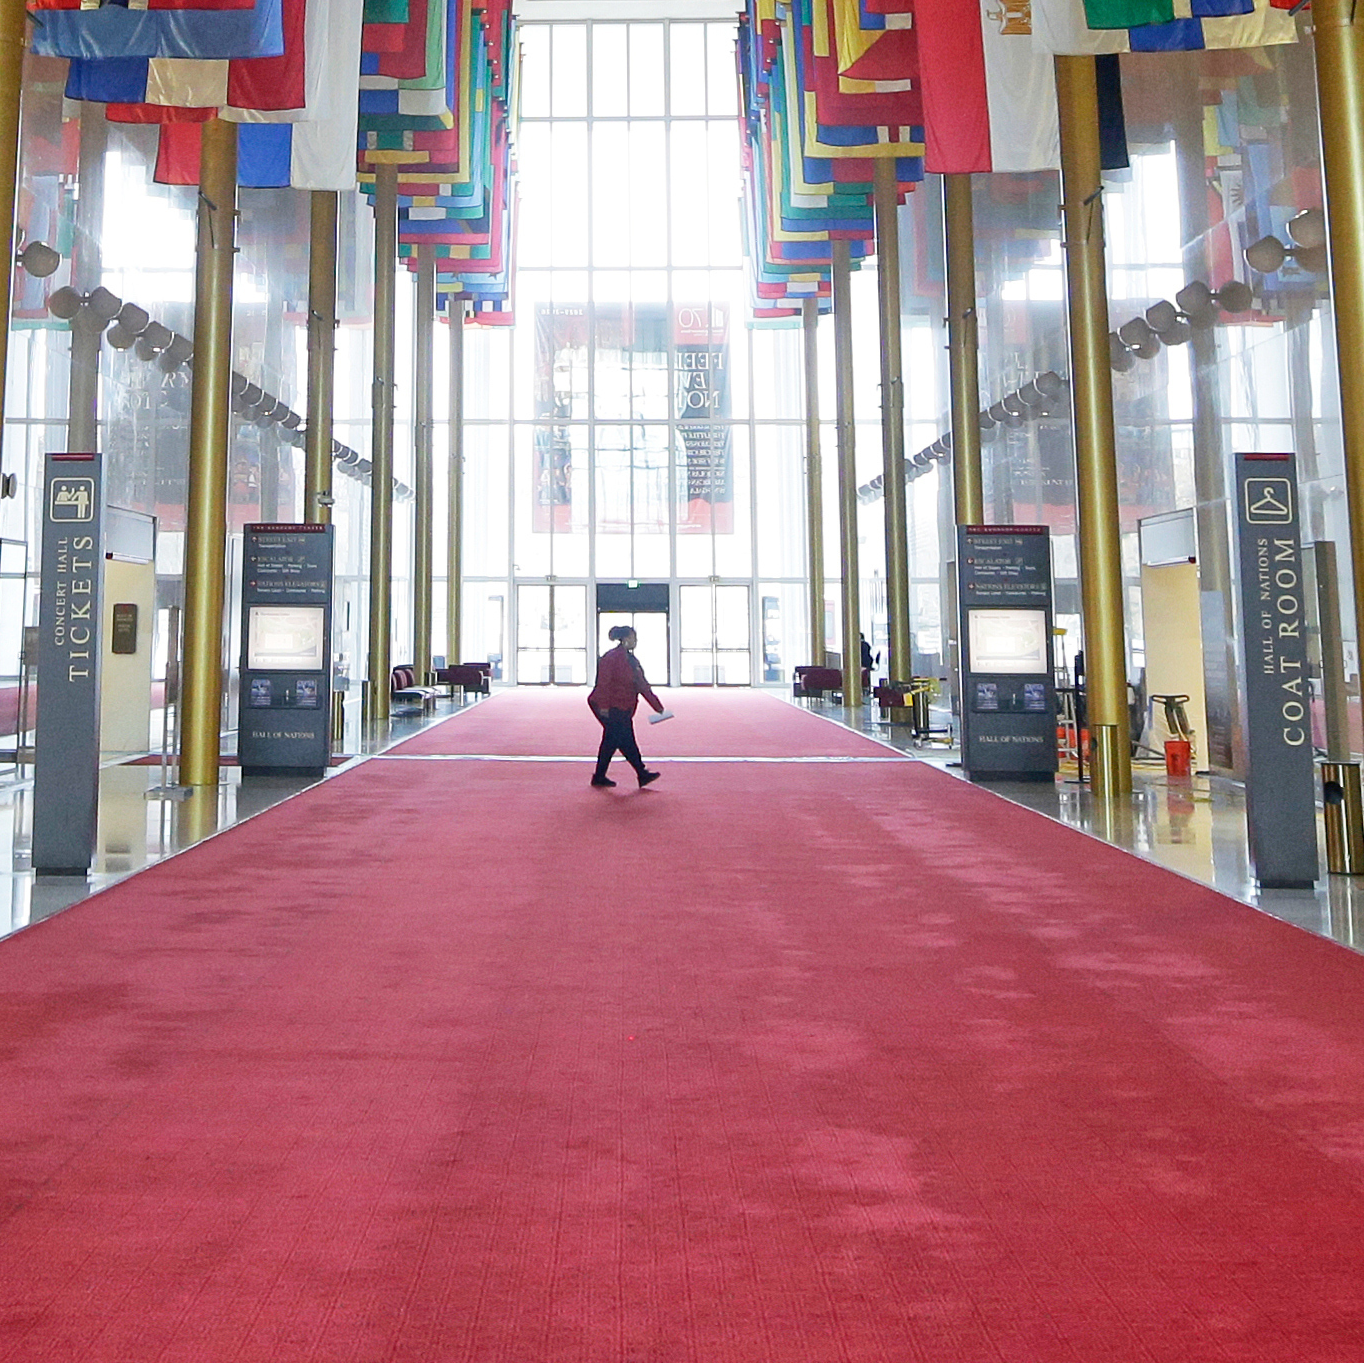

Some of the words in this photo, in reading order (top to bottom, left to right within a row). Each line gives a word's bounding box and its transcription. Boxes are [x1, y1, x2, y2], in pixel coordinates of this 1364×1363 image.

[57, 537, 68, 573] HALL
[1258, 538, 1271, 601] NATIONS
[54, 581, 67, 646] CONCERT
[69, 536, 93, 682] TICKETS
[1261, 610, 1272, 629] OF
[1274, 538, 1300, 639] ROOM
[1263, 636, 1275, 675] HALL
[1280, 656, 1306, 746] COAT
